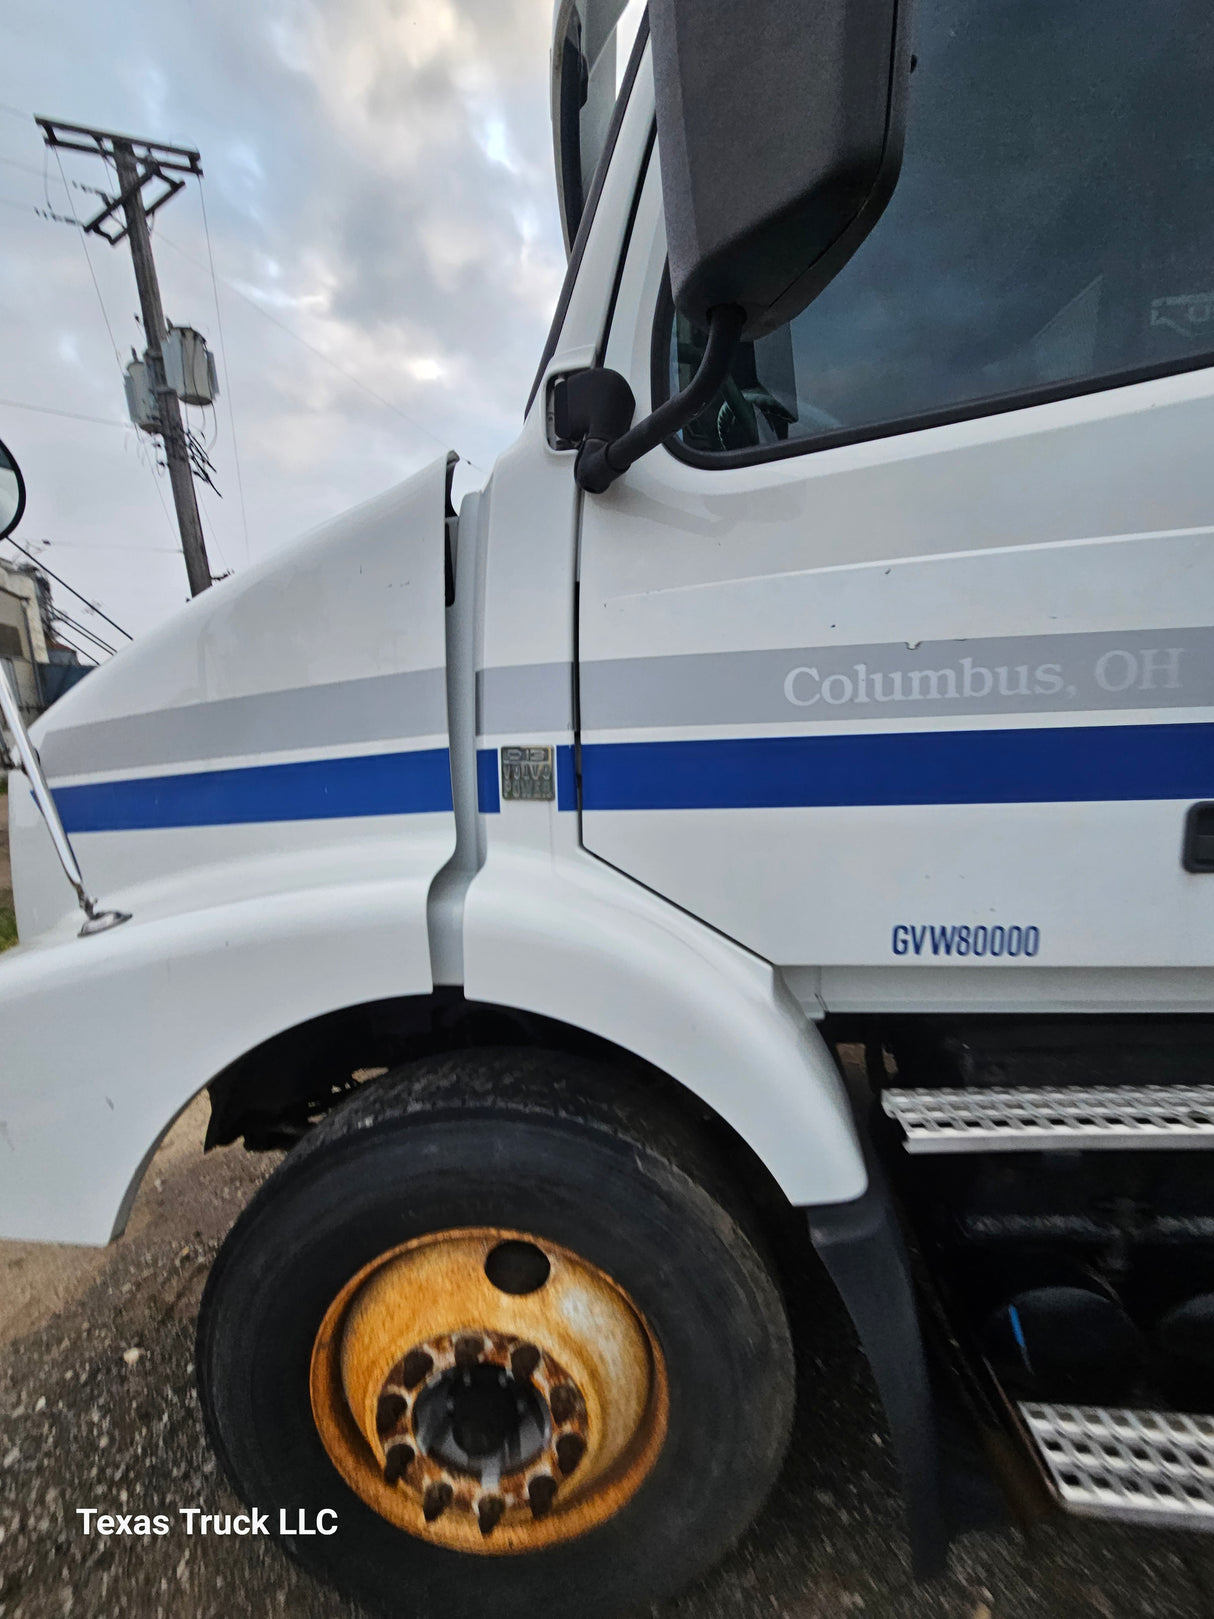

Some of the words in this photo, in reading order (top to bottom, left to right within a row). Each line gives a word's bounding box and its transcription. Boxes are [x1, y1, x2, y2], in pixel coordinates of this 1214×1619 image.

[783, 657, 1077, 706] Columbus,
[1096, 648, 1185, 692] OH
[503, 762, 551, 780] VOLVO
[892, 924, 1040, 957] GVW80000
